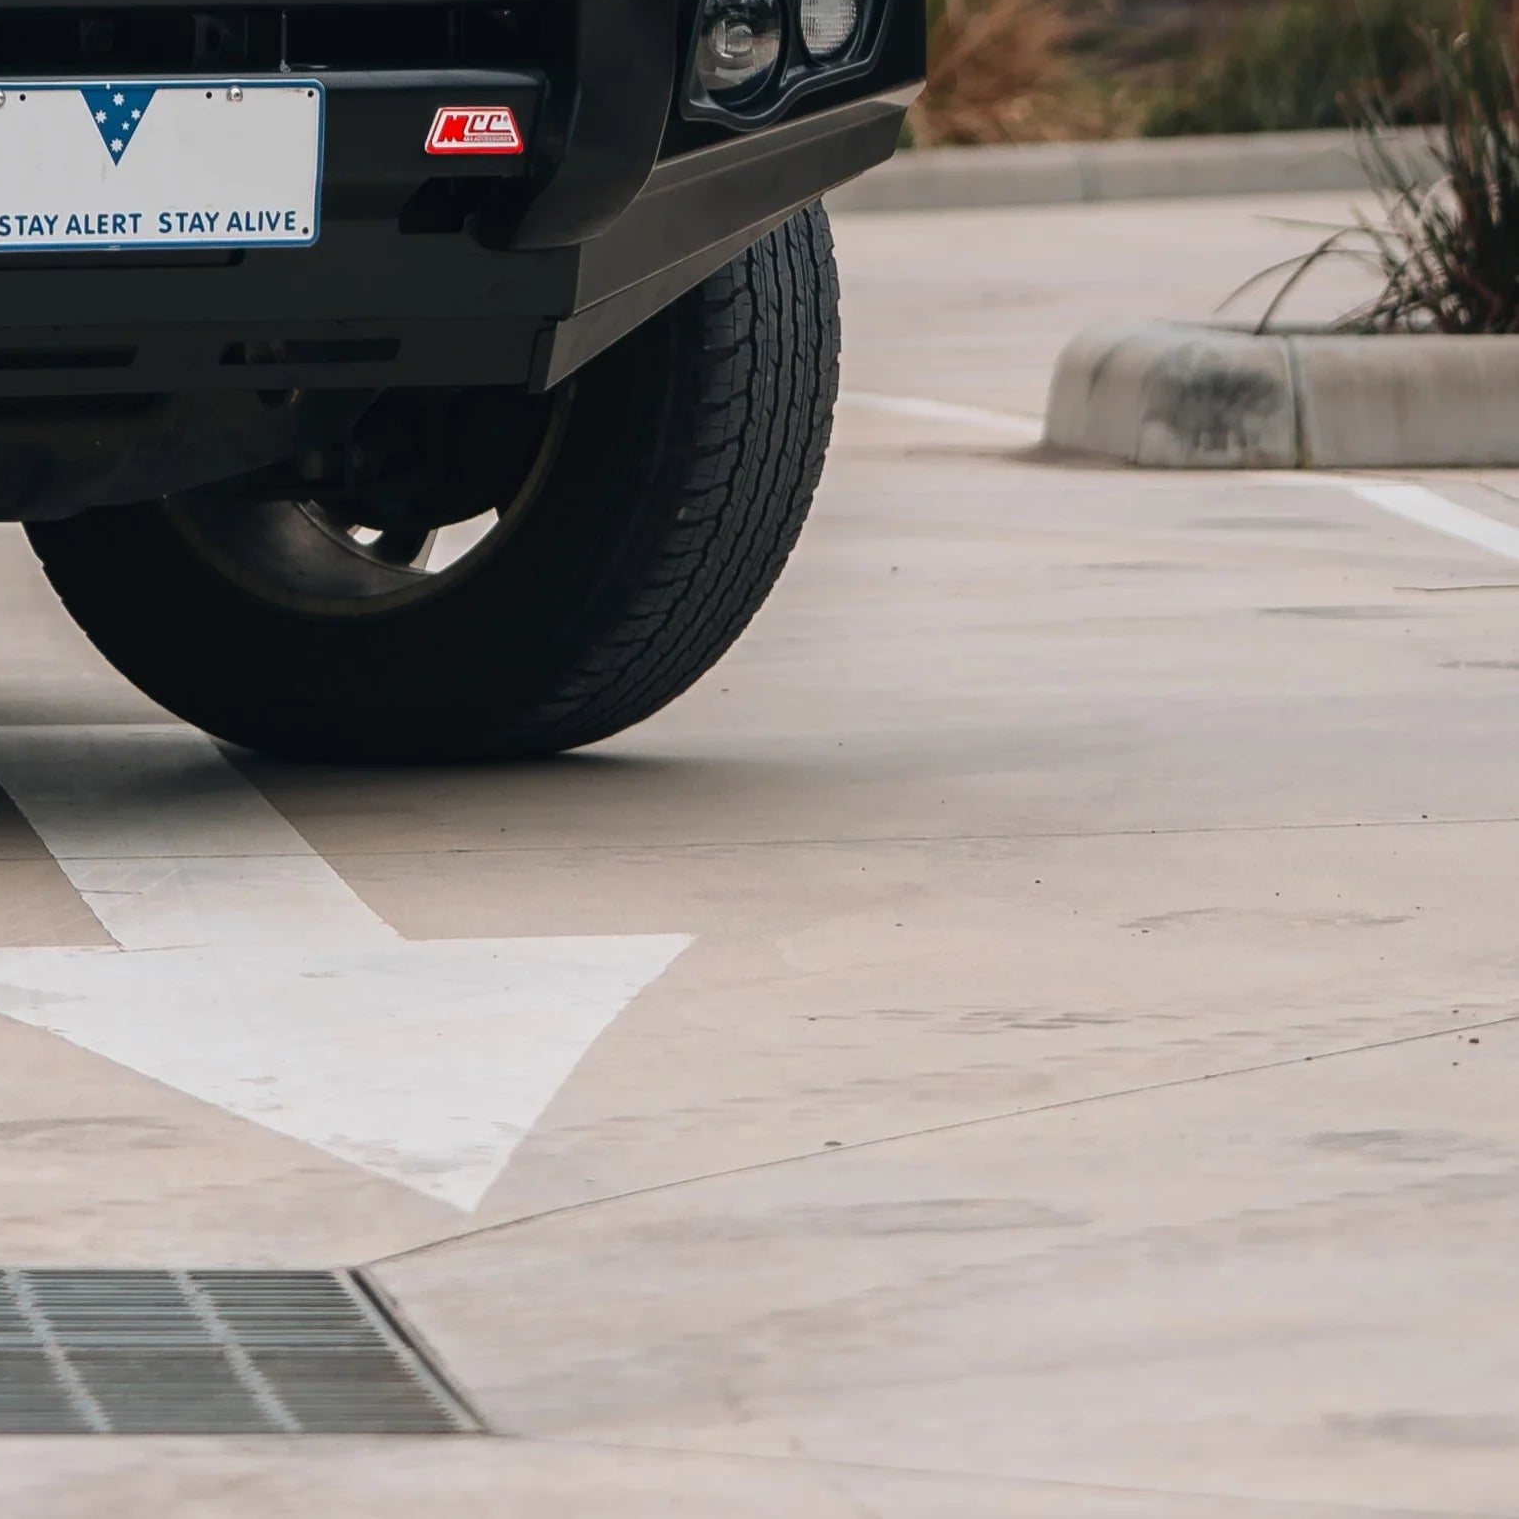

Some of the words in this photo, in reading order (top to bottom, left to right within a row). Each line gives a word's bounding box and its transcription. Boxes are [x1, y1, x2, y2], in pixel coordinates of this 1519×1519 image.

[437, 114, 513, 143] MCC
[65, 211, 143, 236] ALERT
[157, 210, 220, 235] STAY
[226, 209, 297, 233] ALIVE
